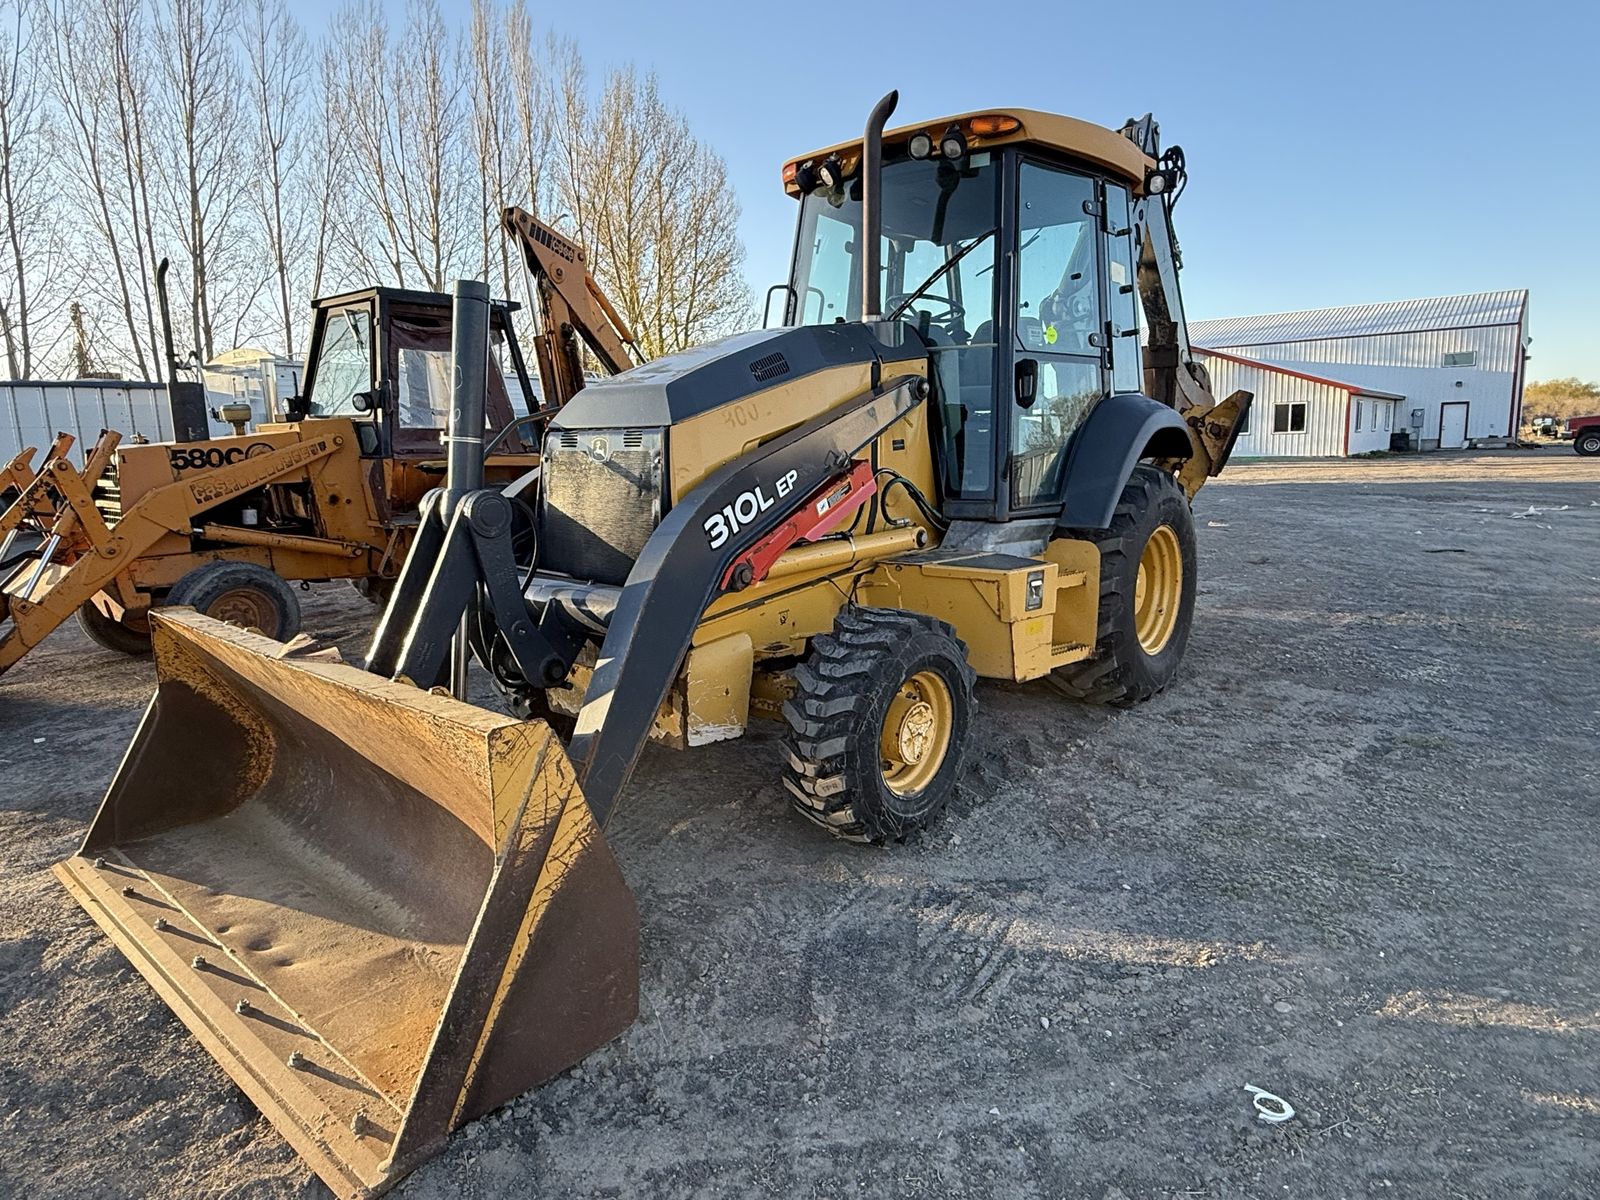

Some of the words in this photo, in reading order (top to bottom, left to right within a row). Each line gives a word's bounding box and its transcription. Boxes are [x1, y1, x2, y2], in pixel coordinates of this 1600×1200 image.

[171, 447, 244, 470] 580C
[703, 486, 775, 550] 310L
[775, 469, 798, 498] EP
